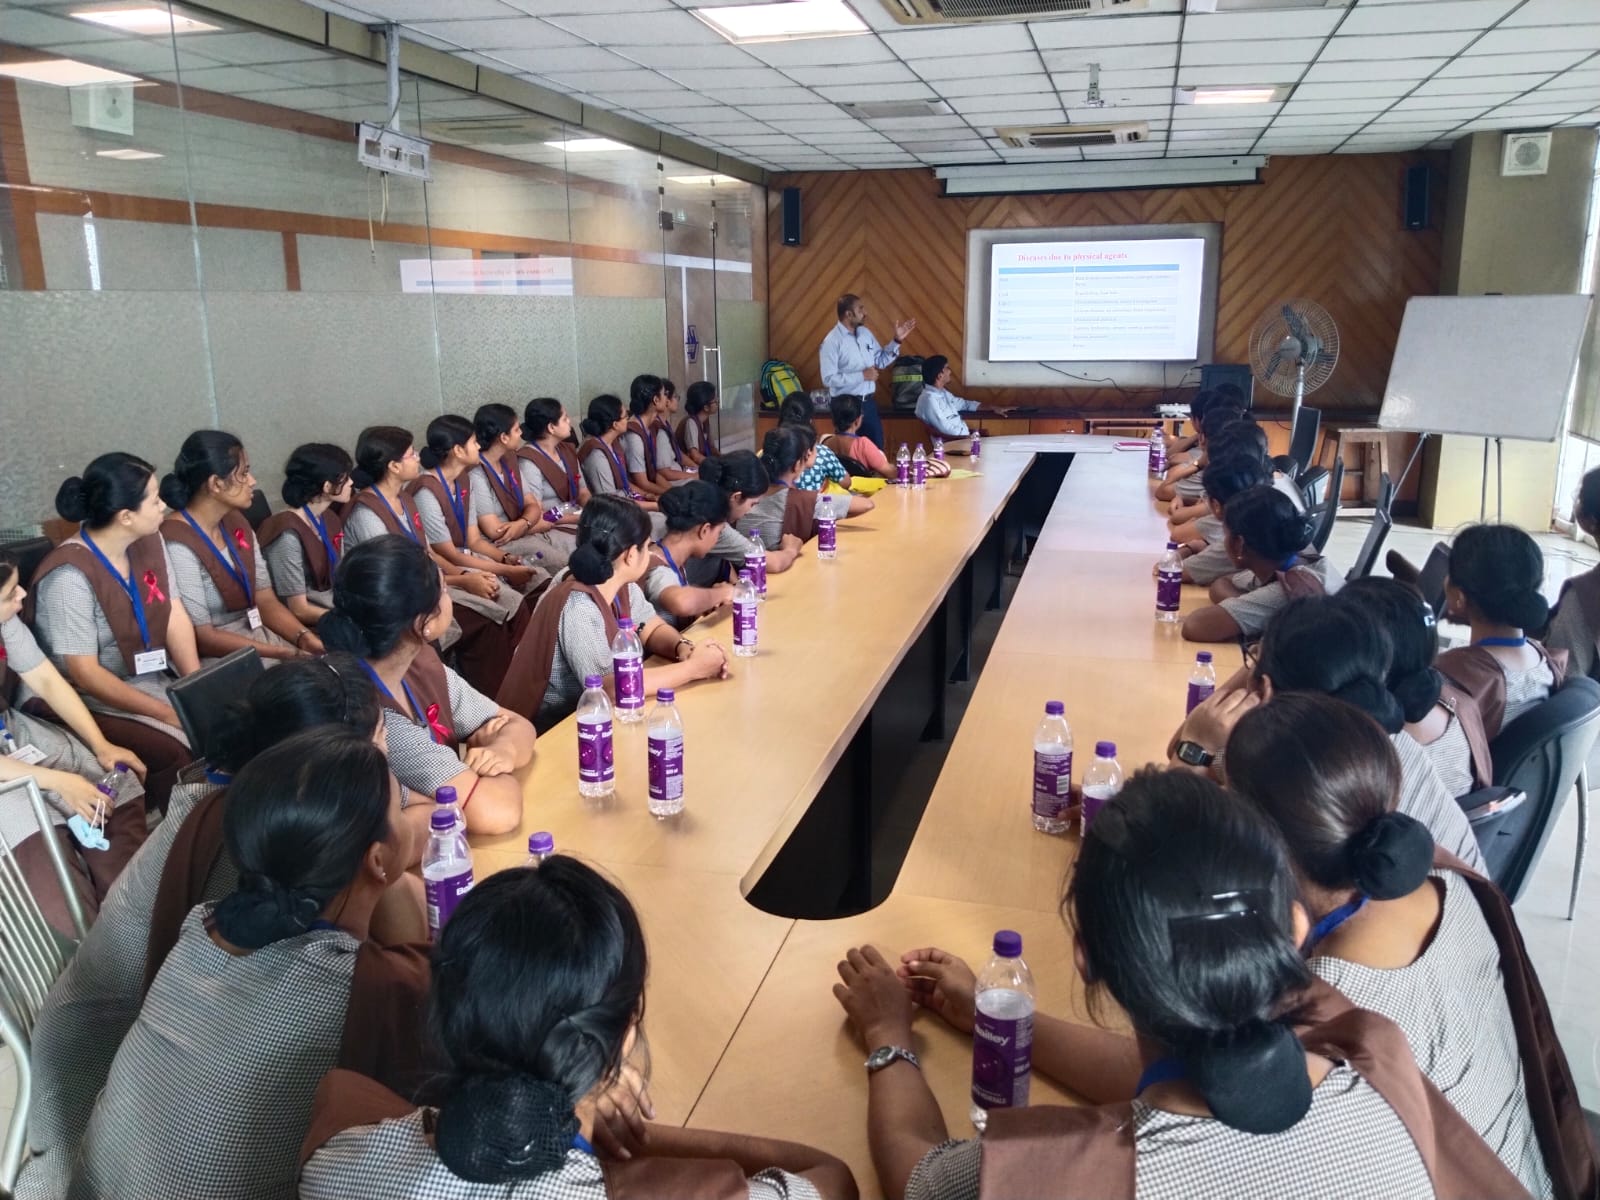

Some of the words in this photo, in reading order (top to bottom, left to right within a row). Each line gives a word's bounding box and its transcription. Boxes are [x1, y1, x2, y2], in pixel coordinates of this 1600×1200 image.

[1018, 254, 1047, 262] Diseases
[1048, 253, 1061, 261] due
[1073, 252, 1103, 262] physical
[1104, 252, 1128, 261] agents
